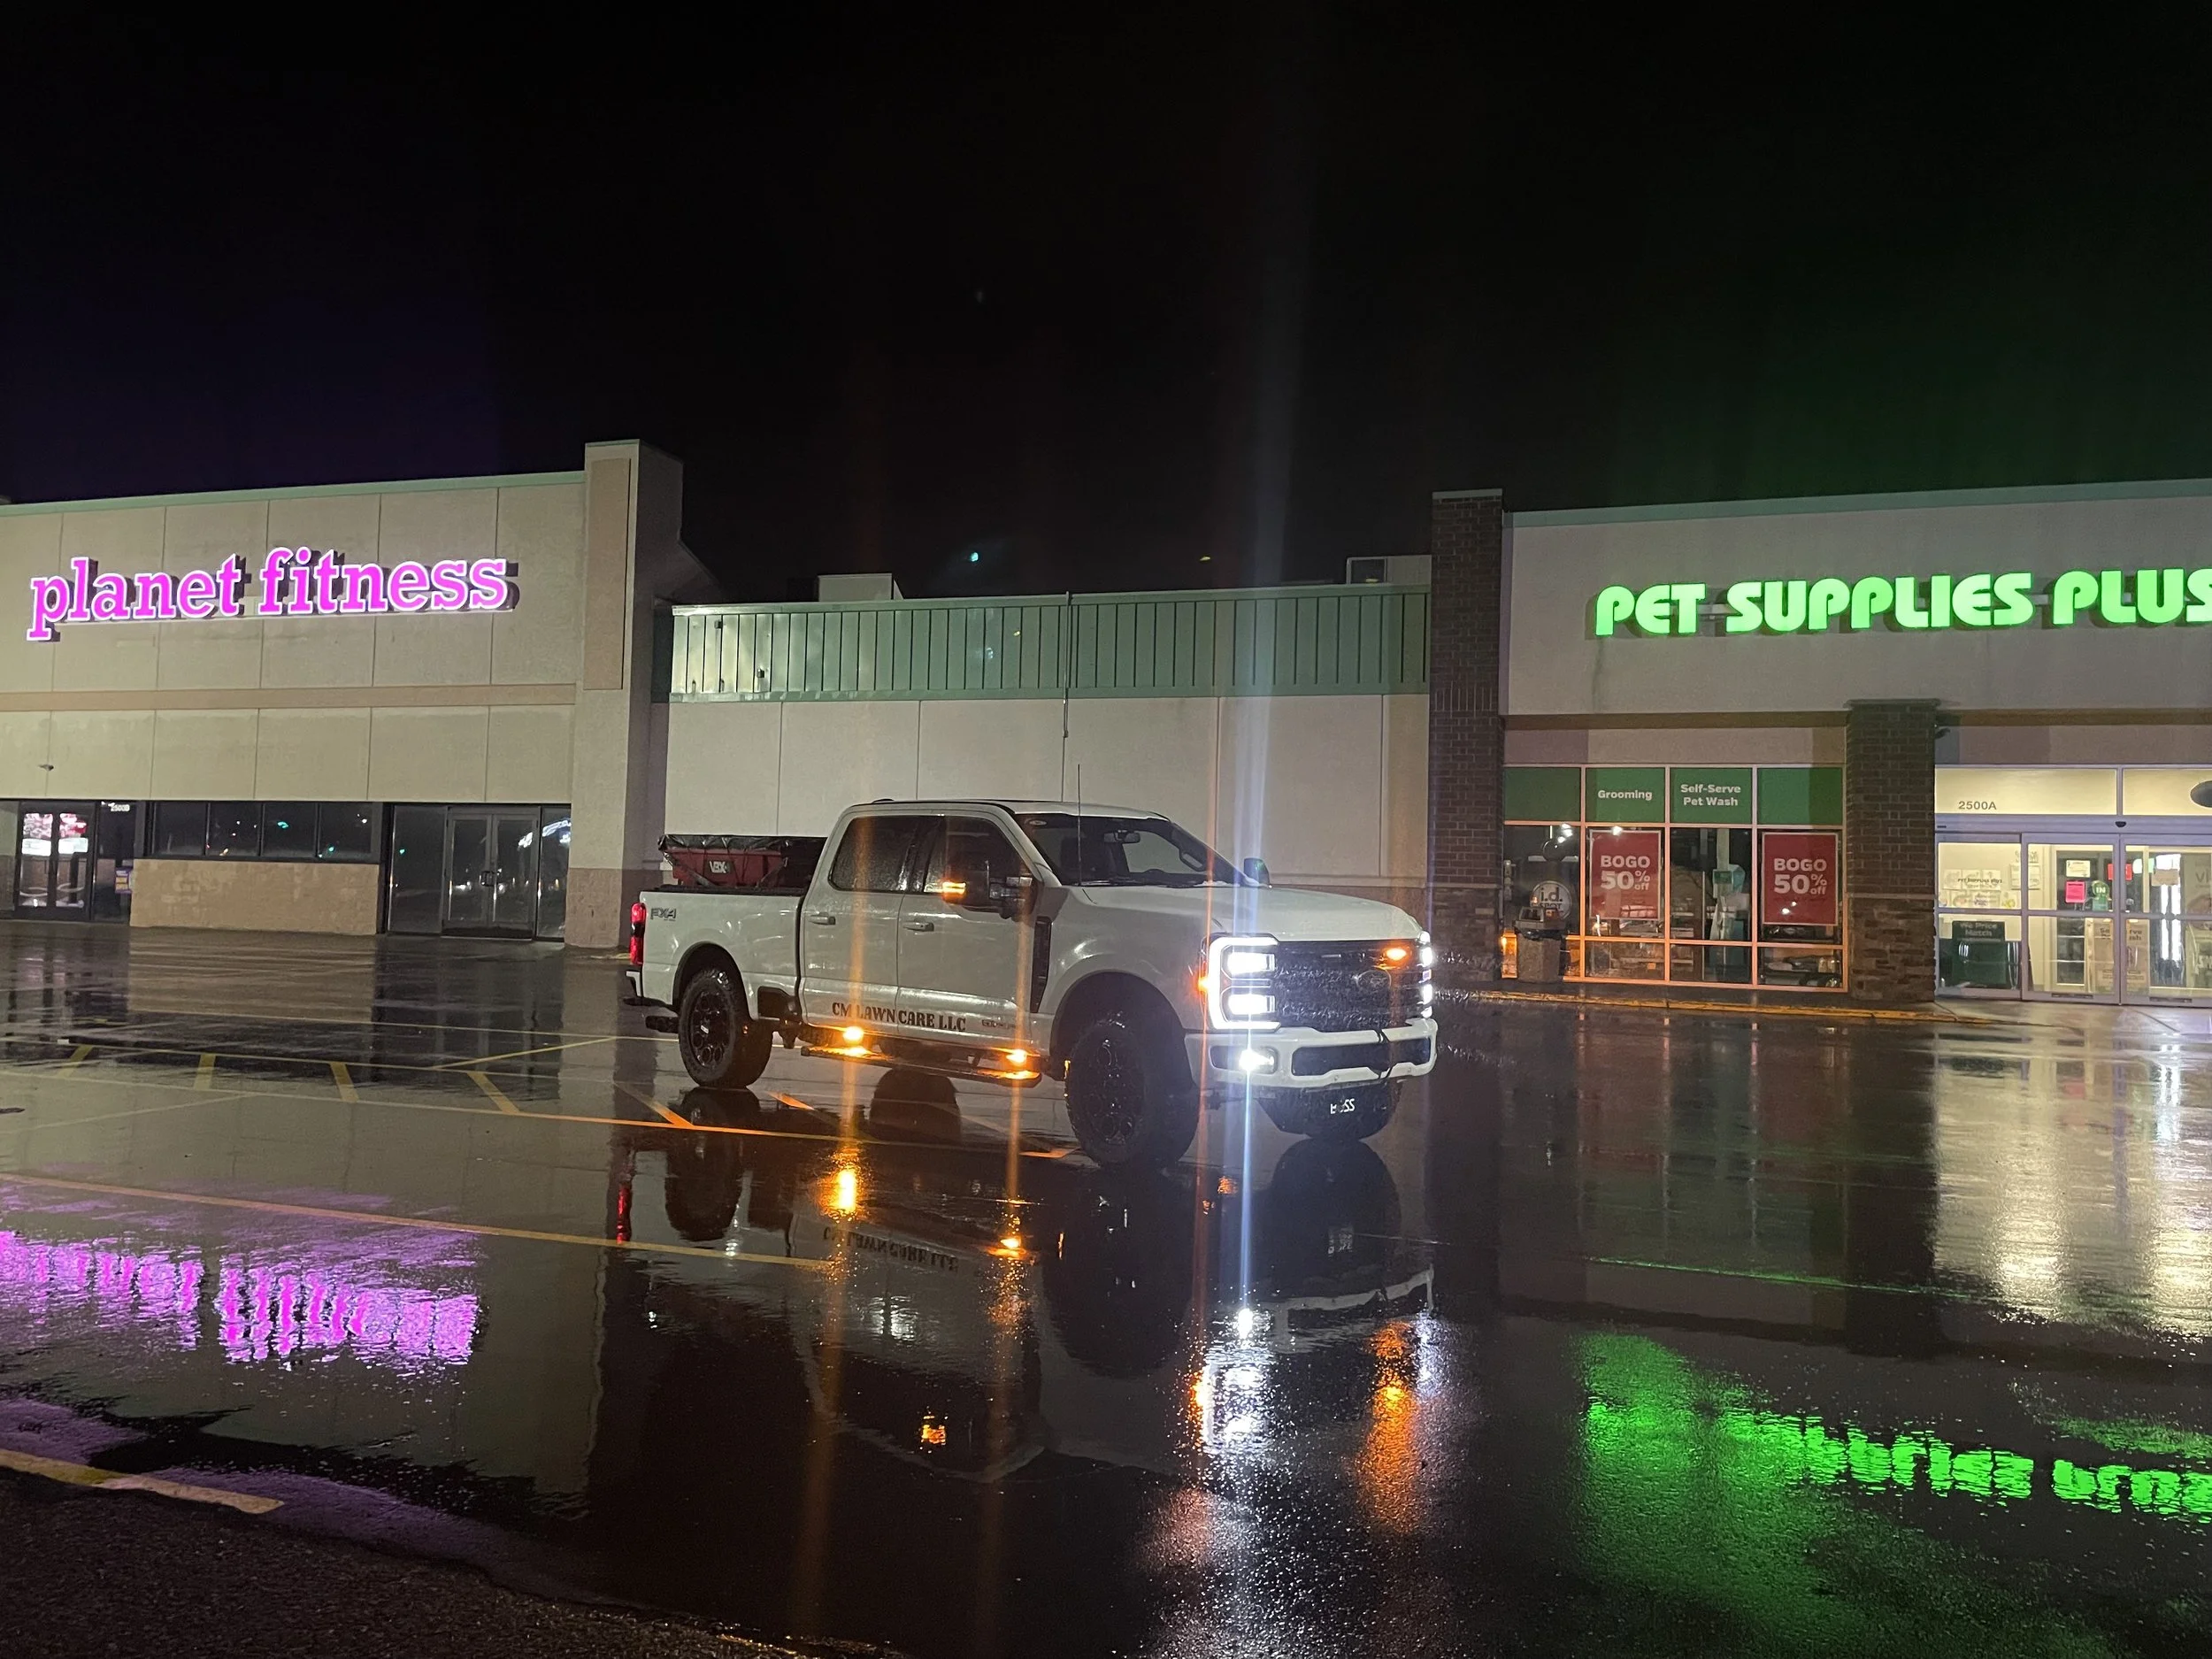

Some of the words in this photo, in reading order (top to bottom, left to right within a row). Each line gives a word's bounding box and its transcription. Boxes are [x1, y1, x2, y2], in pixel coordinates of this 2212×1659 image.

[27, 553, 242, 641] planet
[258, 546, 508, 615] fitness
[1595, 582, 1706, 636] PET
[1726, 572, 2035, 634] SUPPLIES
[2053, 568, 2212, 625] PLUS
[1597, 789, 1653, 801] Grooming
[1680, 784, 1741, 794] Self-Serve
[1683, 796, 1703, 806] Pet
[1706, 796, 1739, 806] Wash
[1958, 801, 1997, 810] 2500A
[1600, 855, 1651, 868] BOGO
[1773, 858, 1827, 872] BOGO
[1810, 885, 1826, 895] off
[856, 1005, 896, 1023] LAWN
[897, 1010, 935, 1028] CARE
[938, 1015, 966, 1033] LLC
